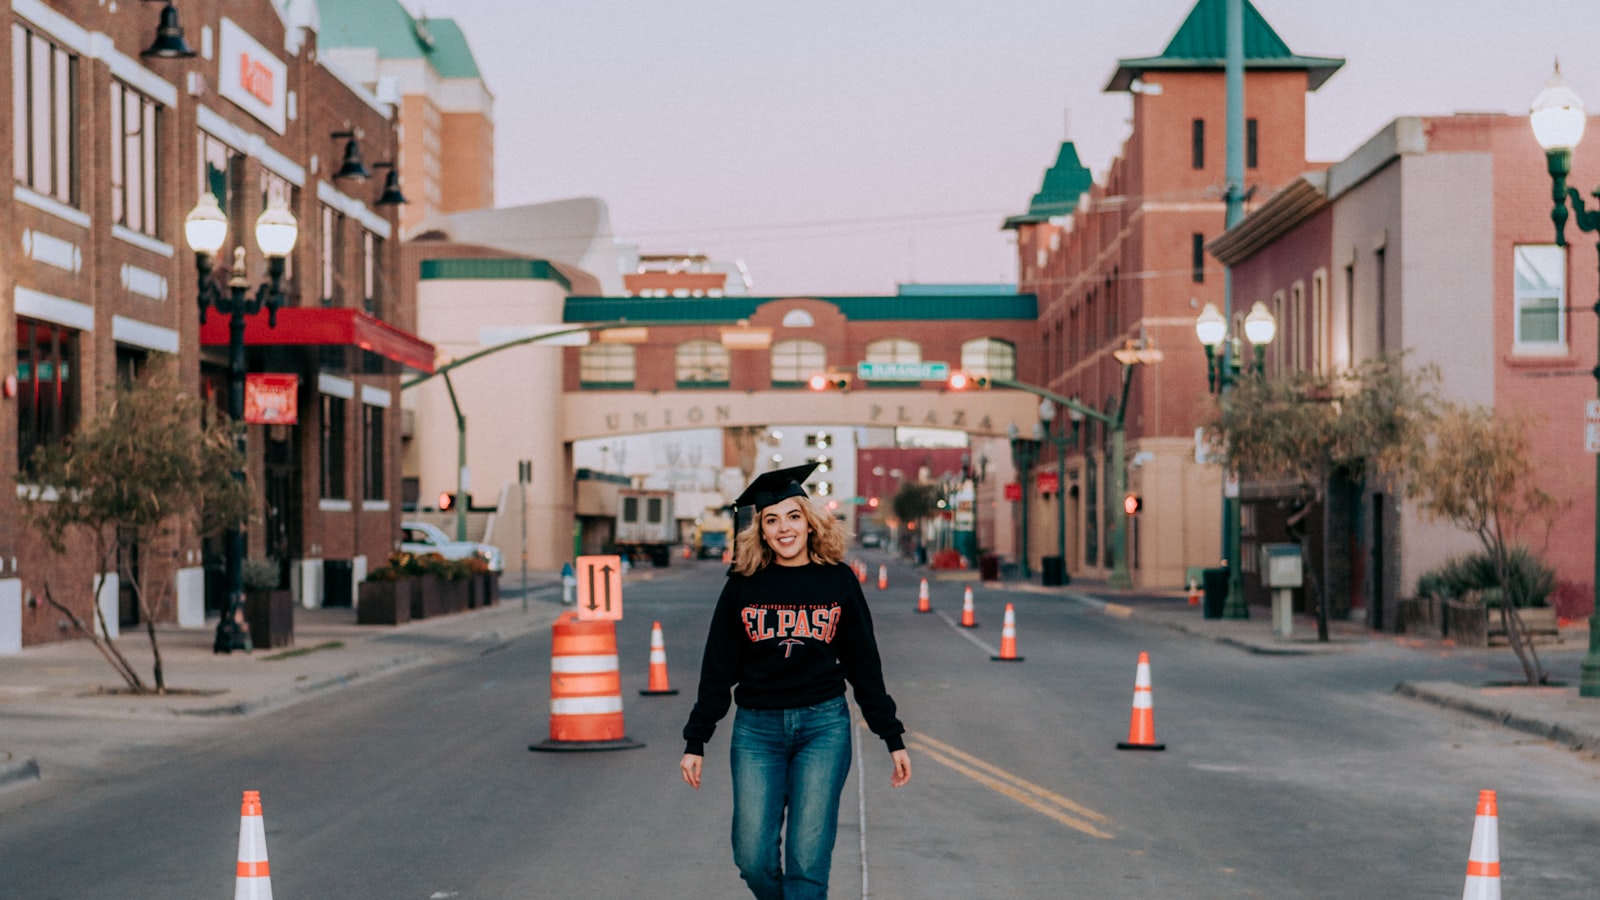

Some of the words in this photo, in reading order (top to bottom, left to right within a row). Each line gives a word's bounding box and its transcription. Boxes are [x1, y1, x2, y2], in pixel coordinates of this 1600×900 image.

[605, 403, 731, 431] UNION
[869, 402, 993, 431] PLAZA
[741, 606, 774, 642] EL
[776, 606, 841, 644] PASO
